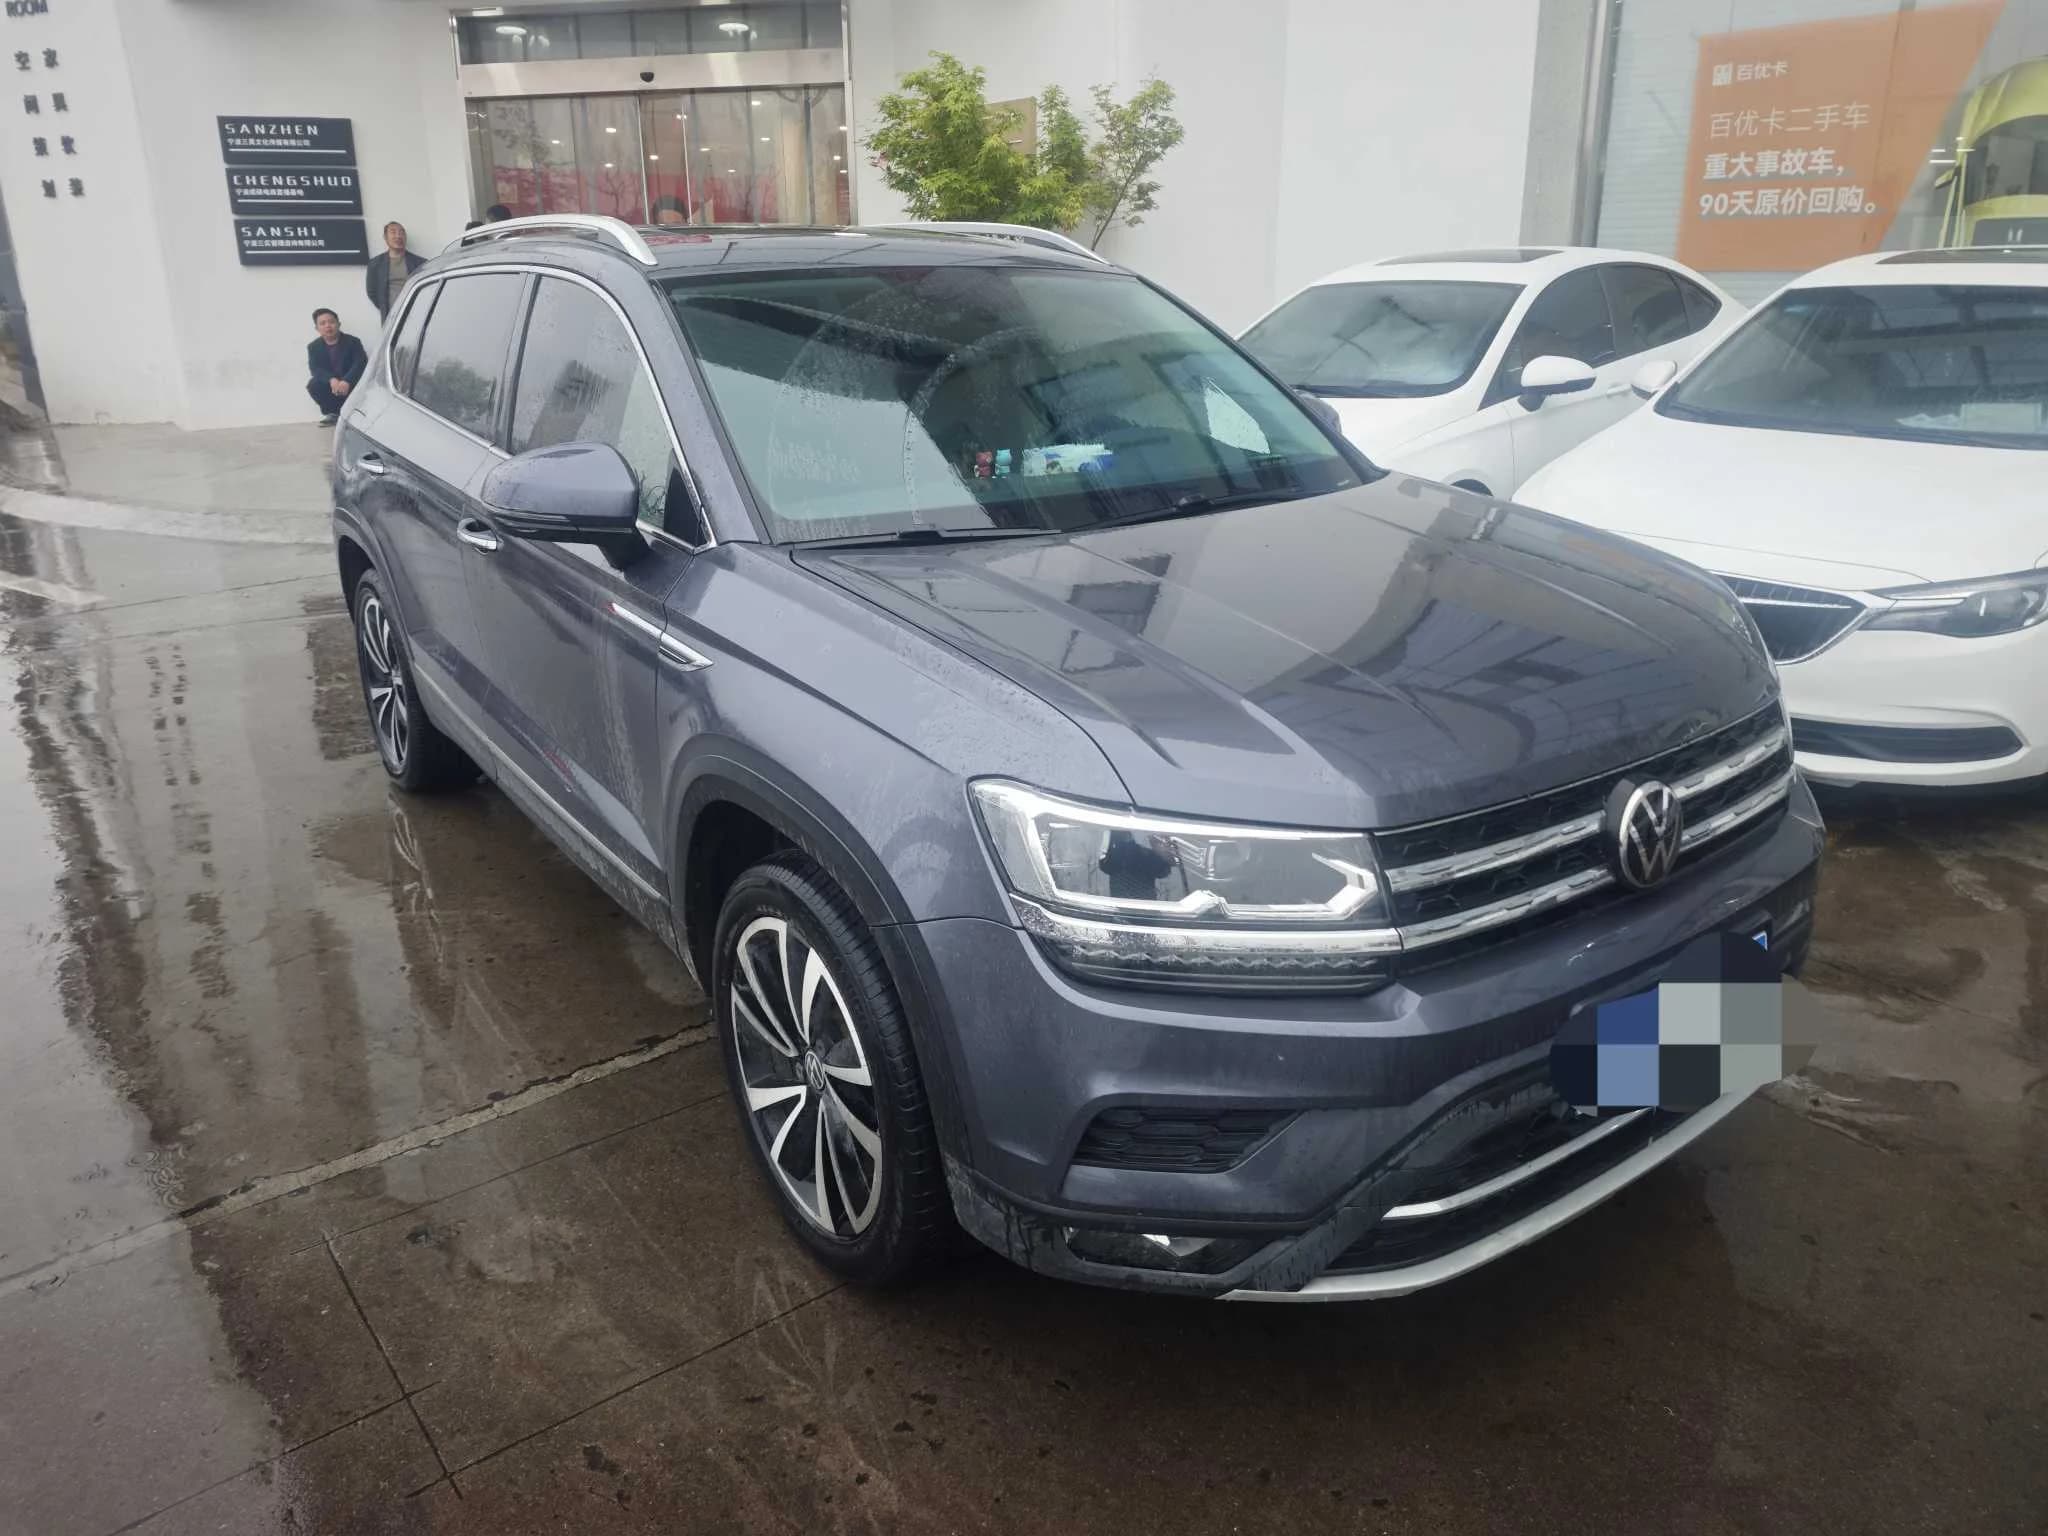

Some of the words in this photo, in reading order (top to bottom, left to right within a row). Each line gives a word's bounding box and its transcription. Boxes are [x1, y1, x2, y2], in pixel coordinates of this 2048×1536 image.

[1736, 61, 1789, 81] 百优卡
[1709, 101, 1871, 138] 百优卡二手车
[224, 123, 319, 136] SANZHEN
[232, 175, 352, 187] CHENGSHUO
[240, 226, 317, 238] SANSHI
